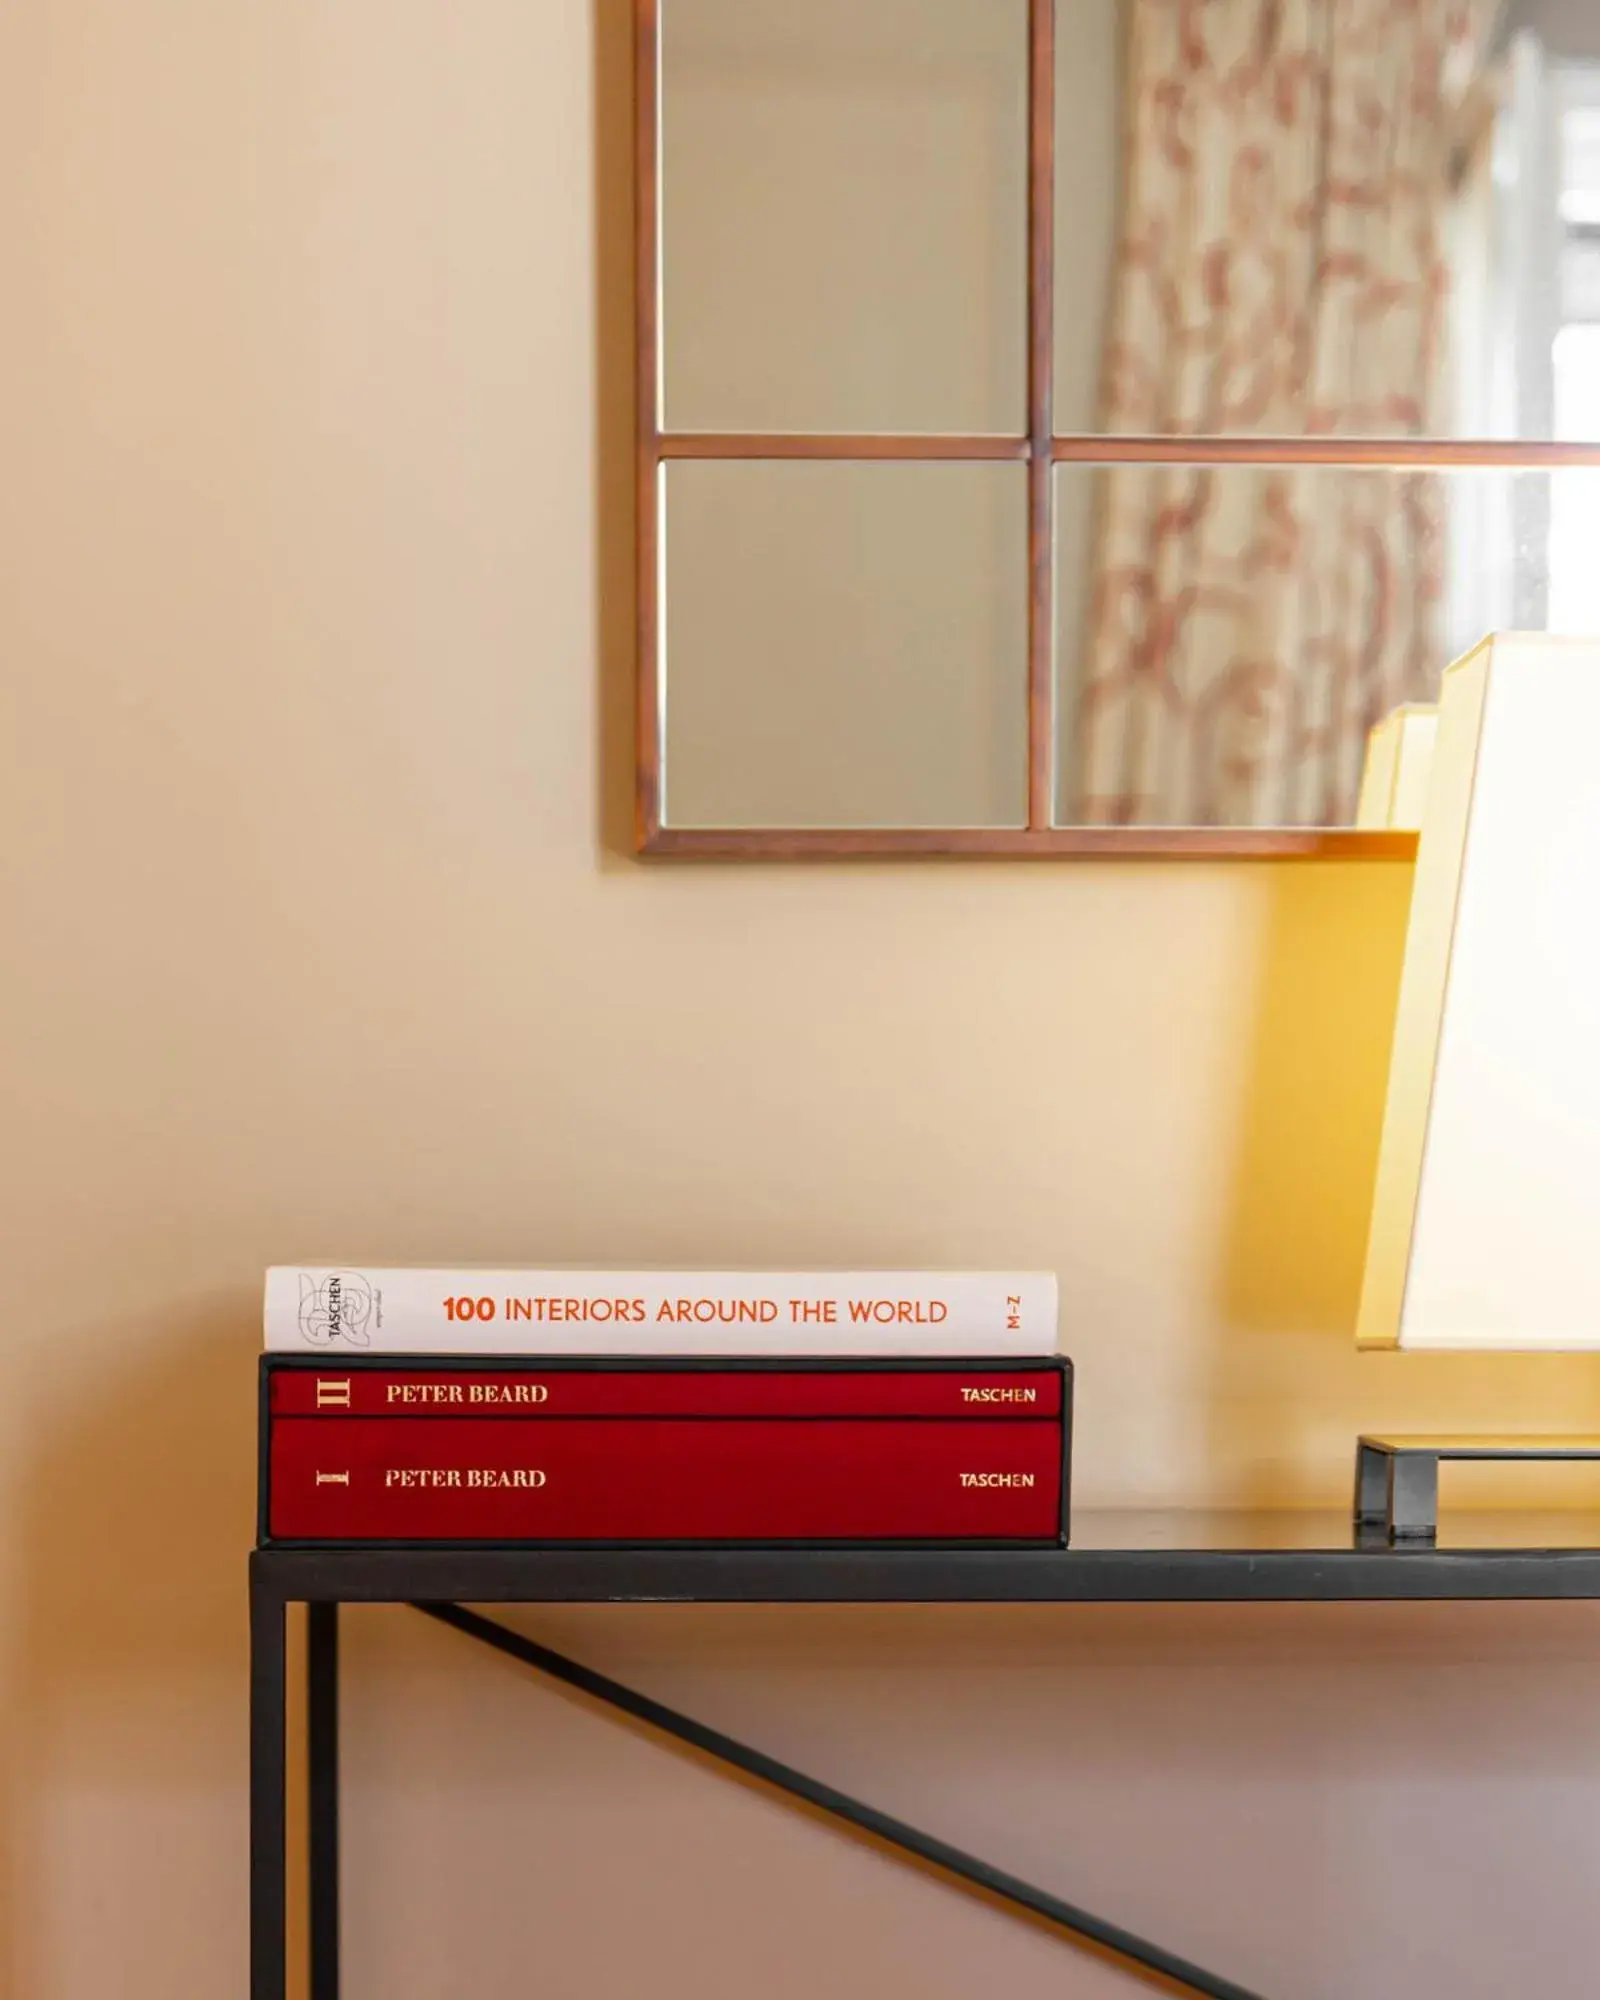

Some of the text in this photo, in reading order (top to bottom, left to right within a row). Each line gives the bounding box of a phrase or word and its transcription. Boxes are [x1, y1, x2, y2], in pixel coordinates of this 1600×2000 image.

[328, 1277, 342, 1338] TASCHEN
[442, 1295, 949, 1325] 100 INTERIORS AROUND THE WORLD
[386, 1384, 549, 1403] PETER BEARD
[960, 1387, 1037, 1403] TASCHEN
[385, 1469, 547, 1488] PETER BEARD
[959, 1472, 1035, 1488] TASCHEN
